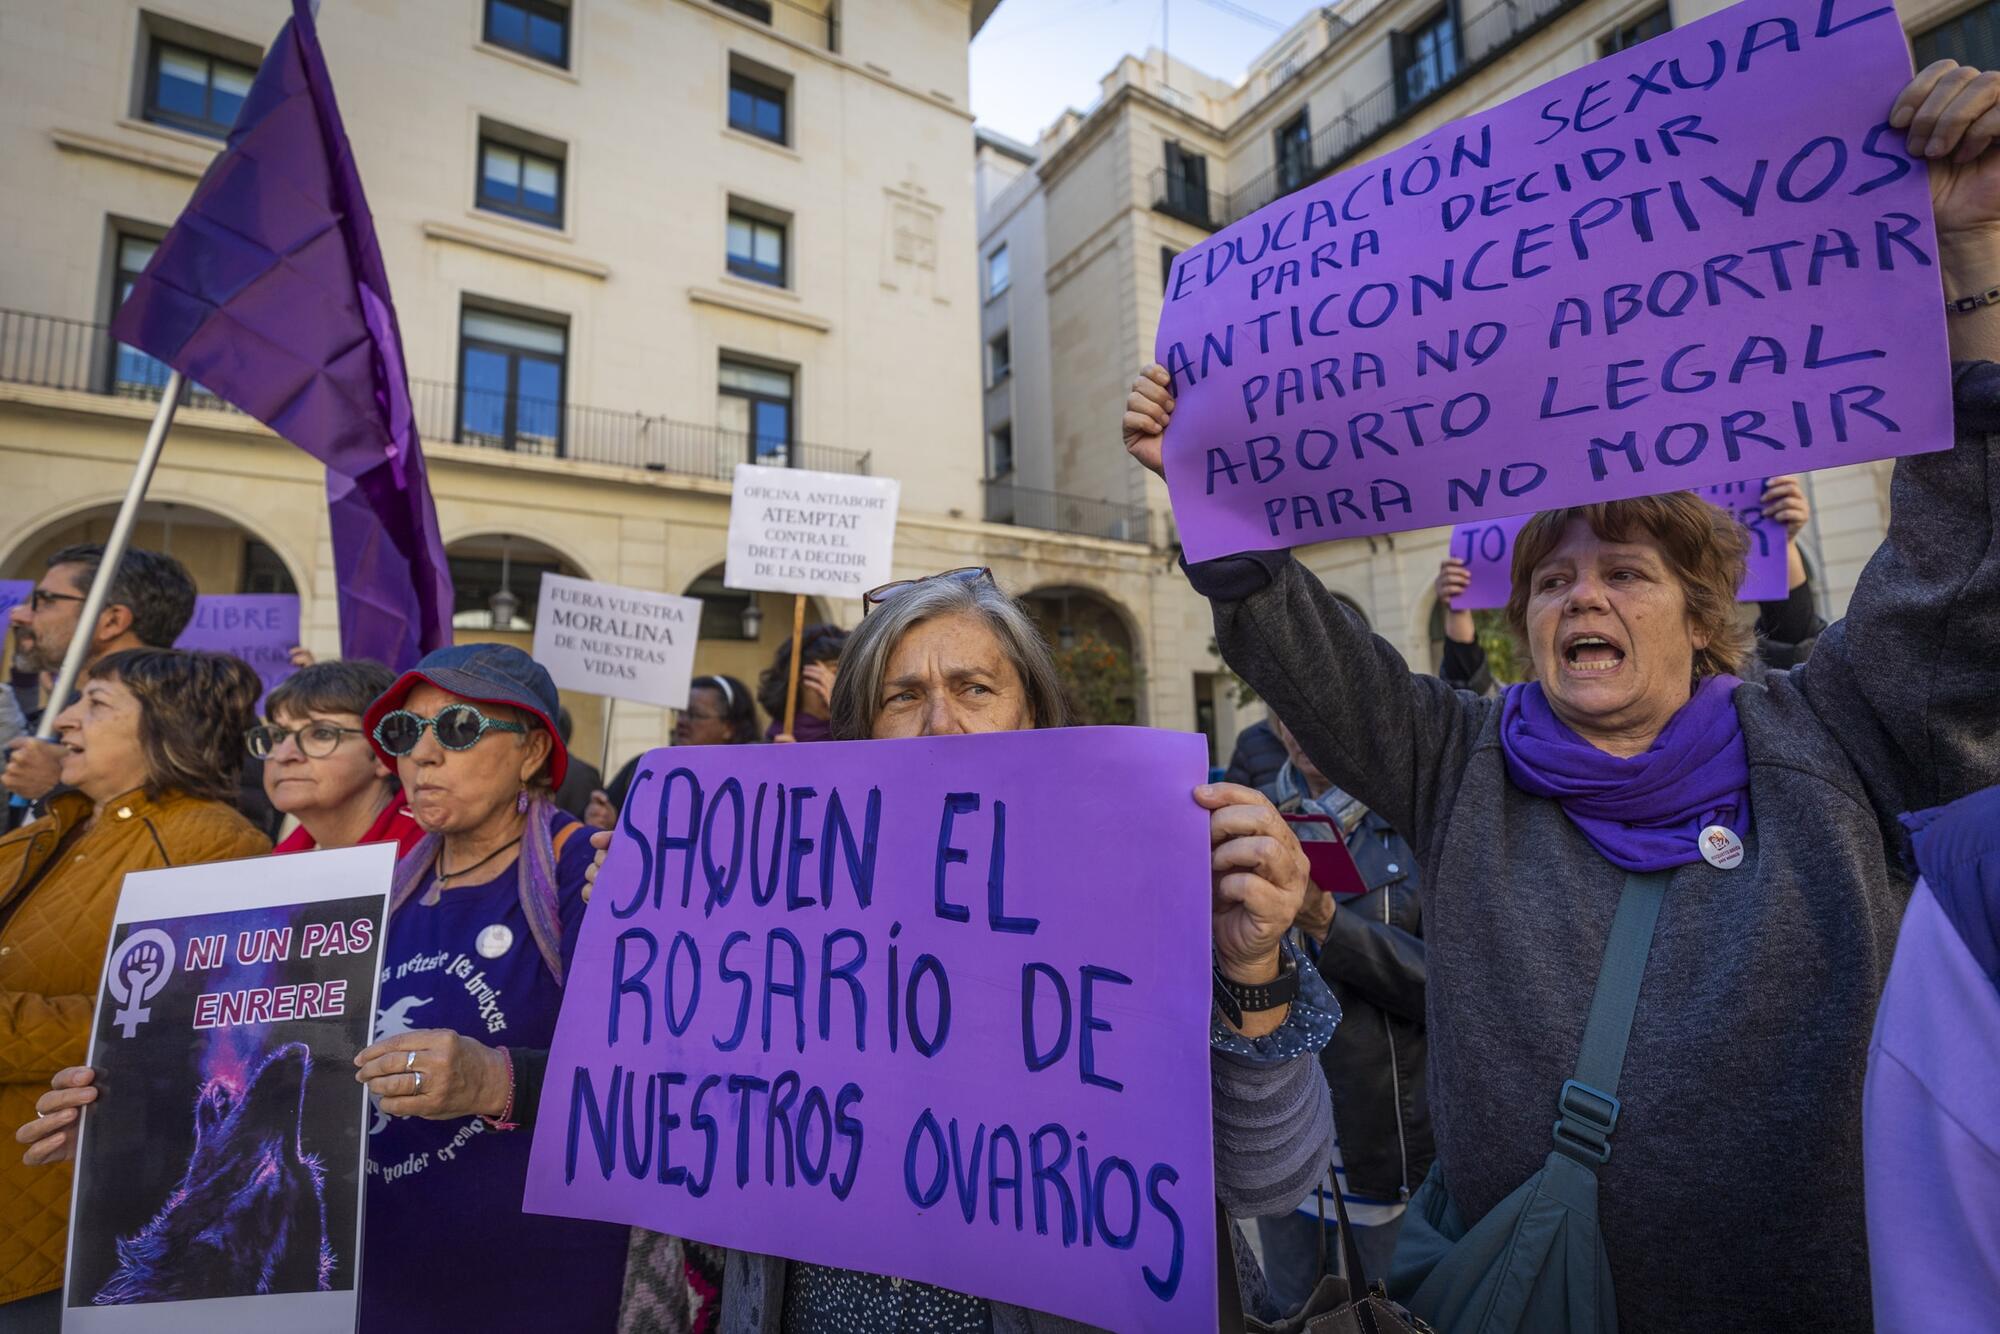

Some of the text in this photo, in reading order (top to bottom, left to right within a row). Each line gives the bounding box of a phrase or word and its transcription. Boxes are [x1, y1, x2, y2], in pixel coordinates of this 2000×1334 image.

[1172, 0, 1894, 301] EDUCACIÓN SEXUAL
[1251, 116, 1719, 300] PARA DECIDIR
[1167, 123, 1911, 397] ANTICONCEPTIVOS
[1243, 213, 1931, 424] PARA NO ABORTAR
[1206, 325, 1886, 494] ABORTO LEGAL
[1264, 386, 1901, 536] PARA NO MORIR
[744, 487, 887, 509] OFICINA ANTIABORT
[762, 507, 860, 529] ATEMPTAT
[748, 545, 867, 567] DRET A DECIDIR
[765, 528, 849, 547] CONTRA EL
[754, 563, 861, 583] DE LES DONES
[196, 604, 281, 631] LIBRE
[551, 588, 684, 622] FUERA VUESTRA
[552, 609, 675, 646] MORALINA
[554, 634, 666, 664] DE NUESTRAS
[583, 658, 637, 679] VIDAS
[611, 767, 1041, 935] SAQUEN EL
[184, 918, 373, 971] NI UN PAS
[192, 980, 347, 1030] ENRERE
[445, 953, 475, 979] les
[464, 971, 508, 1034] bruixes
[1022, 962, 1132, 1092] DE
[565, 1065, 863, 1200] NUESTROS
[383, 1152, 430, 1184] poder
